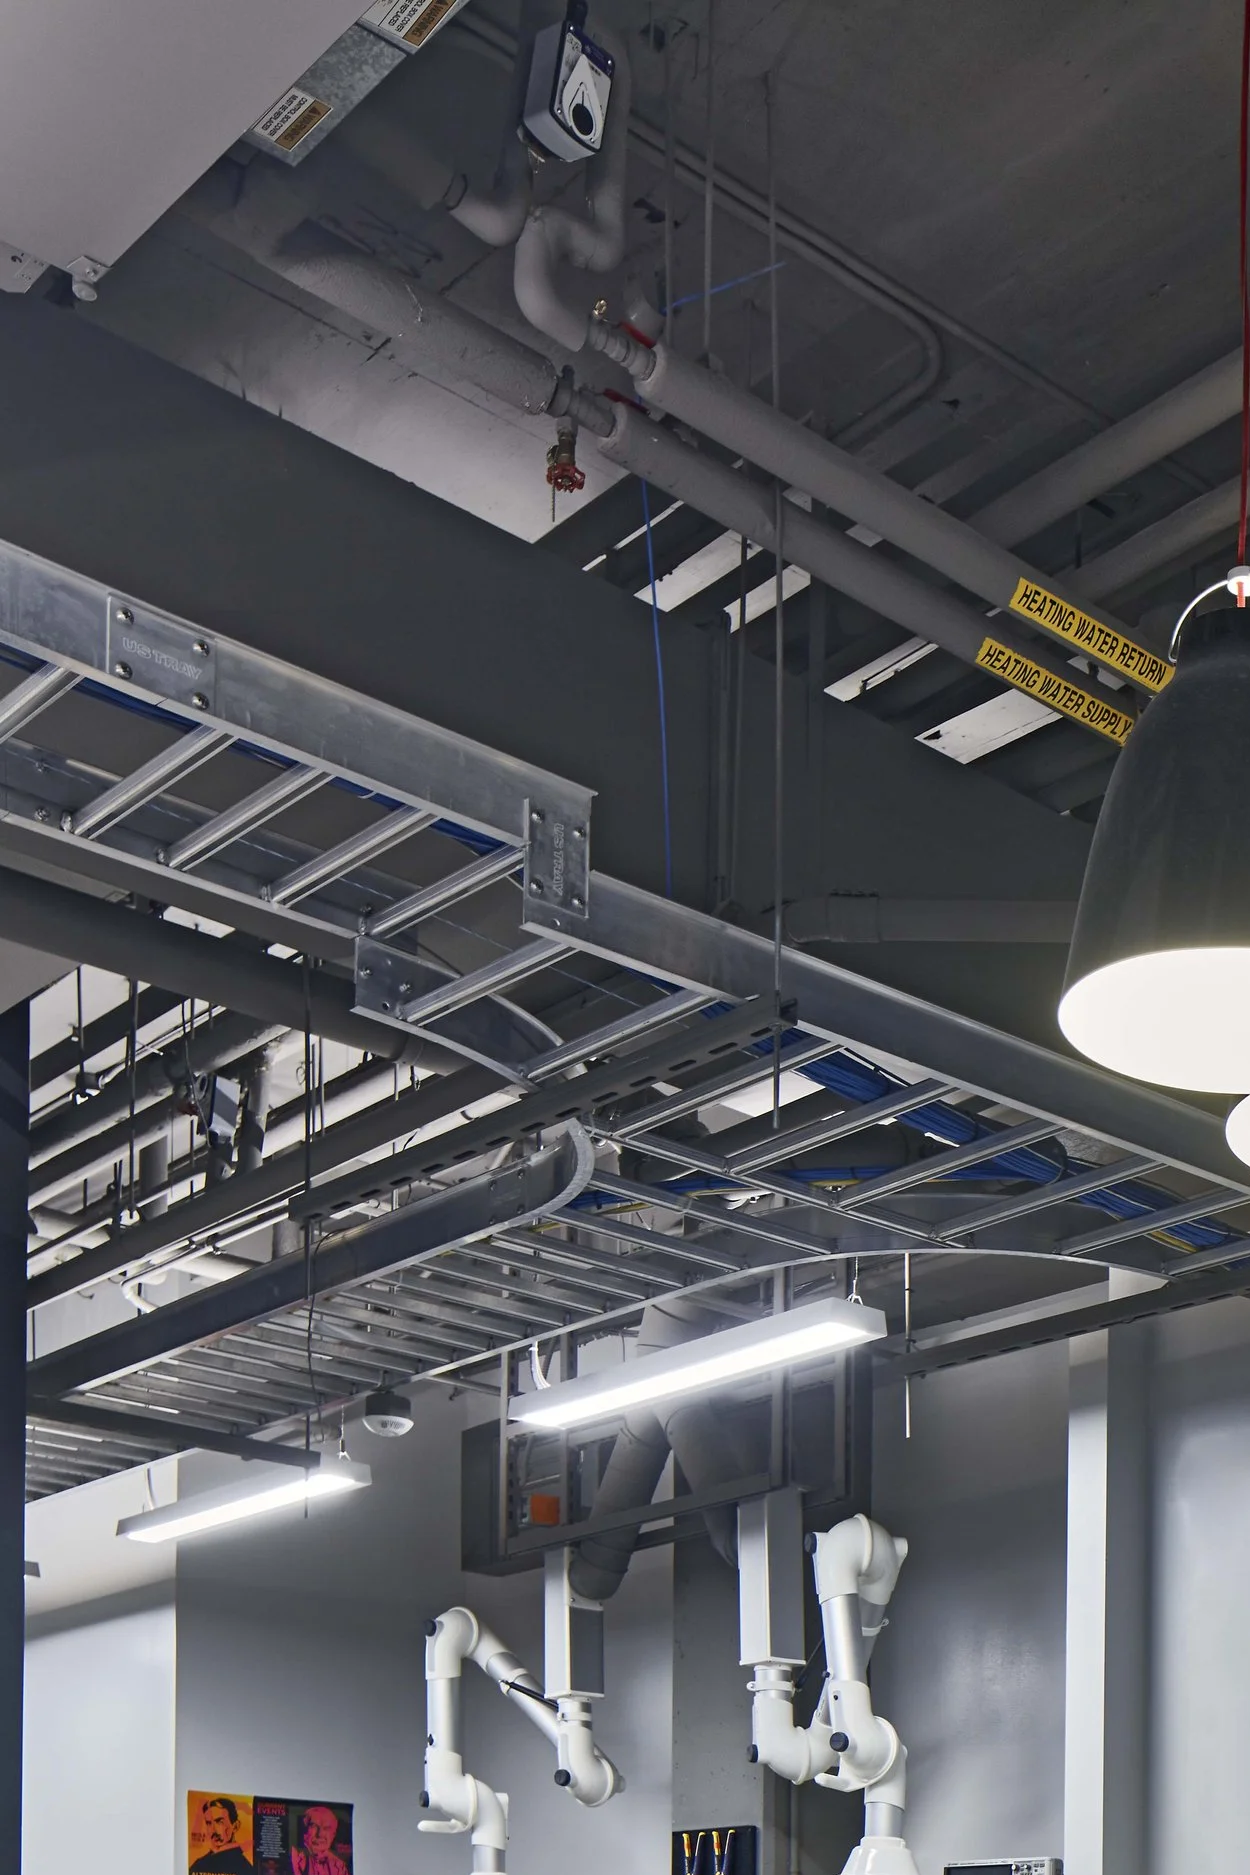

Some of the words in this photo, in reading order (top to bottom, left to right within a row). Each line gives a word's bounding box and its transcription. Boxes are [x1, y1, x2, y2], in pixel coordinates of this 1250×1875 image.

[411, 5, 443, 38] WARNING
[287, 97, 308, 117] CONTROL
[267, 123, 283, 138] COVER
[1017, 585, 1075, 632] HEATING
[1074, 616, 1119, 658] WATER
[1116, 640, 1166, 685] RETURN
[122, 637, 152, 659] US
[152, 649, 203, 680] TRAY
[981, 645, 1040, 688] HEATING
[1038, 675, 1085, 714] WATER
[1082, 700, 1133, 738] SUPPLY
[553, 823, 564, 849] US
[553, 850, 564, 896] TRAY
